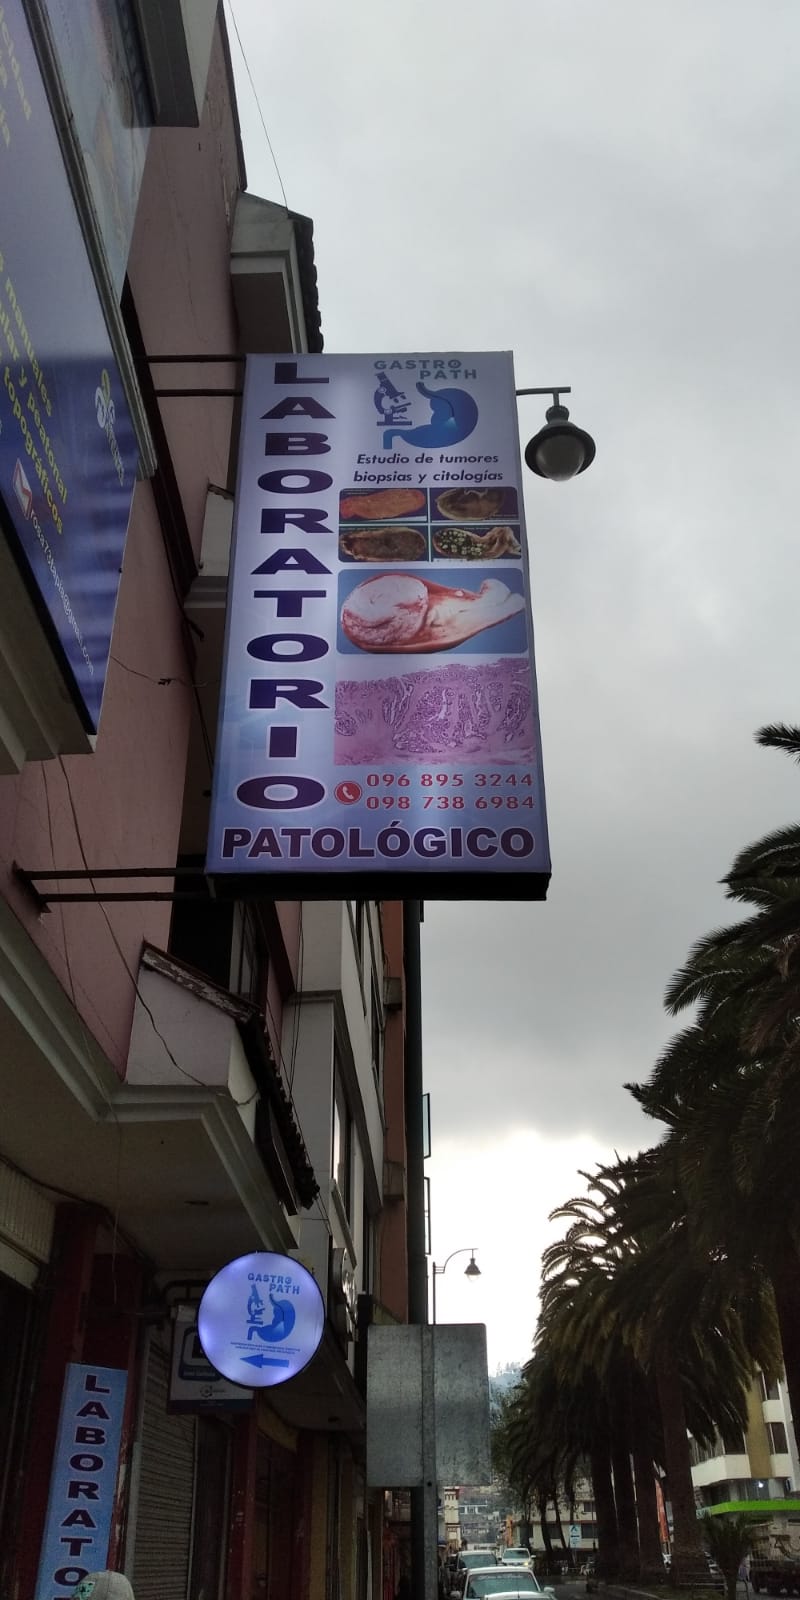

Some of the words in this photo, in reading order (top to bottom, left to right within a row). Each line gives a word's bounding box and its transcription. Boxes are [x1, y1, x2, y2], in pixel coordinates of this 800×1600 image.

[5, 277, 52, 417] manuales
[373, 359, 462, 370] GASTRO
[419, 369, 477, 380] PATH
[19, 365, 28, 388] y
[27, 391, 68, 504] peatonal
[4, 366, 63, 535] topográficos
[356, 453, 410, 465] Estudio
[414, 453, 434, 464] de
[439, 453, 499, 464] tumores
[353, 470, 412, 484] biopsias
[418, 473, 427, 484] y
[433, 469, 503, 483] citologías
[236, 362, 336, 810] LABORATORIO
[366, 773, 411, 787] 096
[420, 773, 464, 787] 895
[474, 773, 533, 787] 3244
[366, 796, 411, 810] 098
[422, 796, 466, 810] 738
[475, 796, 535, 809] 6984
[221, 820, 535, 858] PATOLÓGICO
[247, 1272, 293, 1285] GASTRO
[269, 1282, 300, 1295] PATH
[54, 1374, 110, 1600] LABORATO
